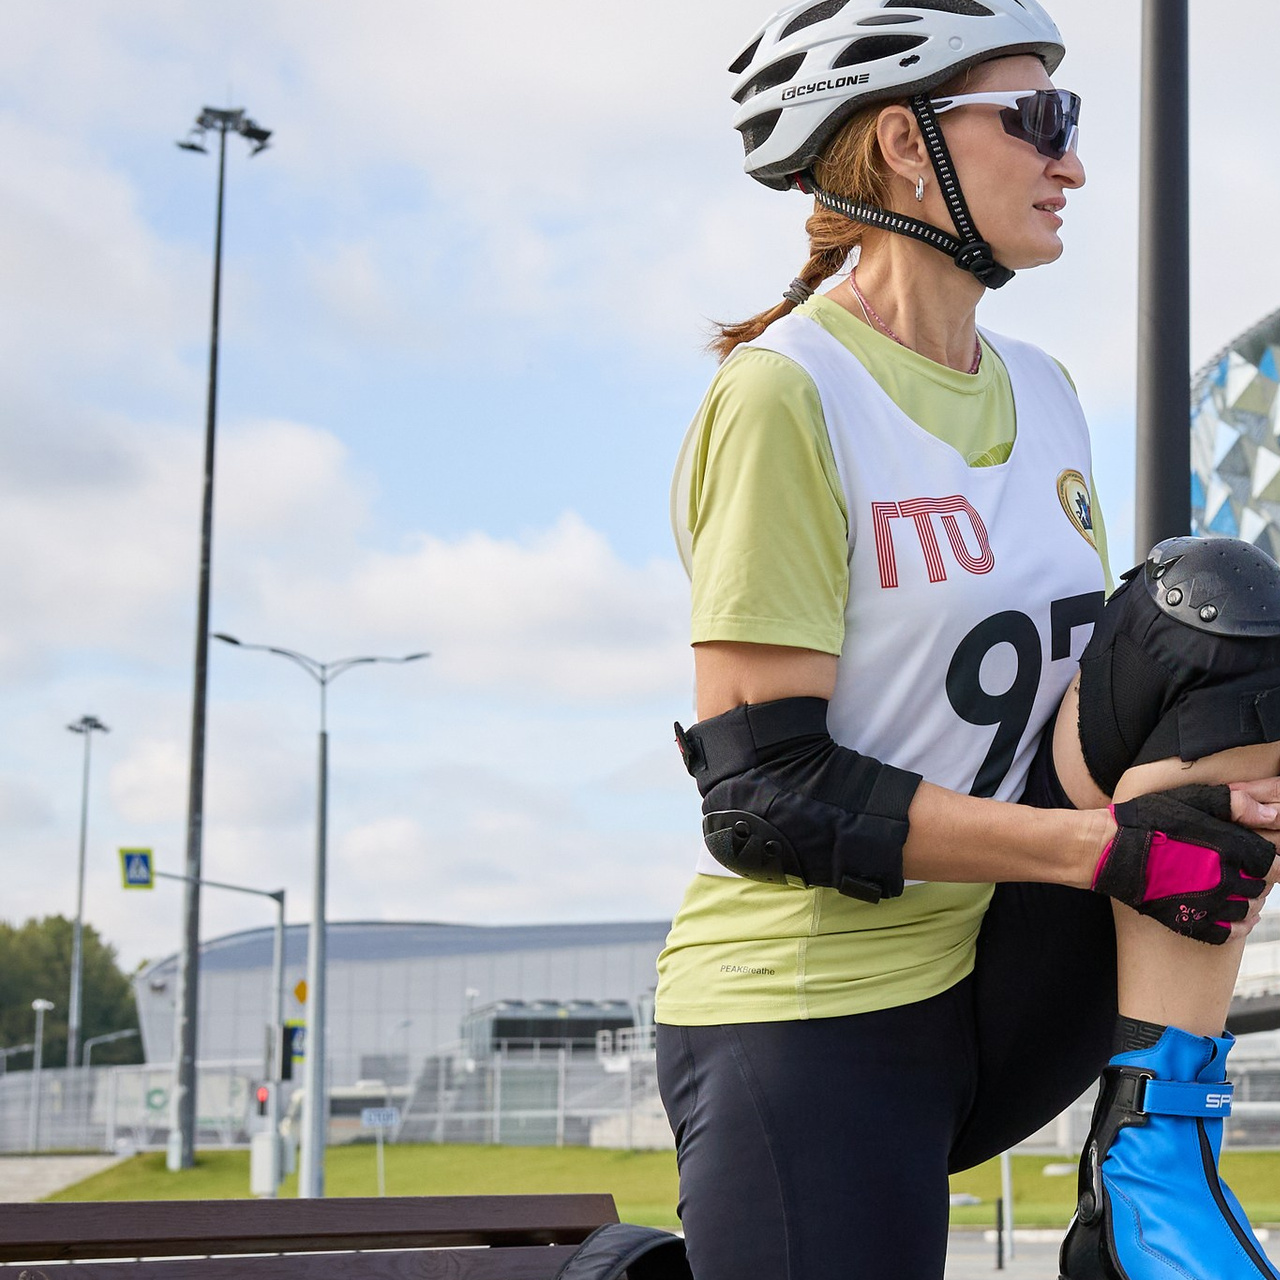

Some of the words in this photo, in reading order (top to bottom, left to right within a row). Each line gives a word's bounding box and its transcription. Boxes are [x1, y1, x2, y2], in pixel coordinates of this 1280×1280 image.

[797, 74, 870, 96] CYCLONE
[871, 495, 995, 588] ГТО
[720, 964, 776, 976] PEAKBreathe
